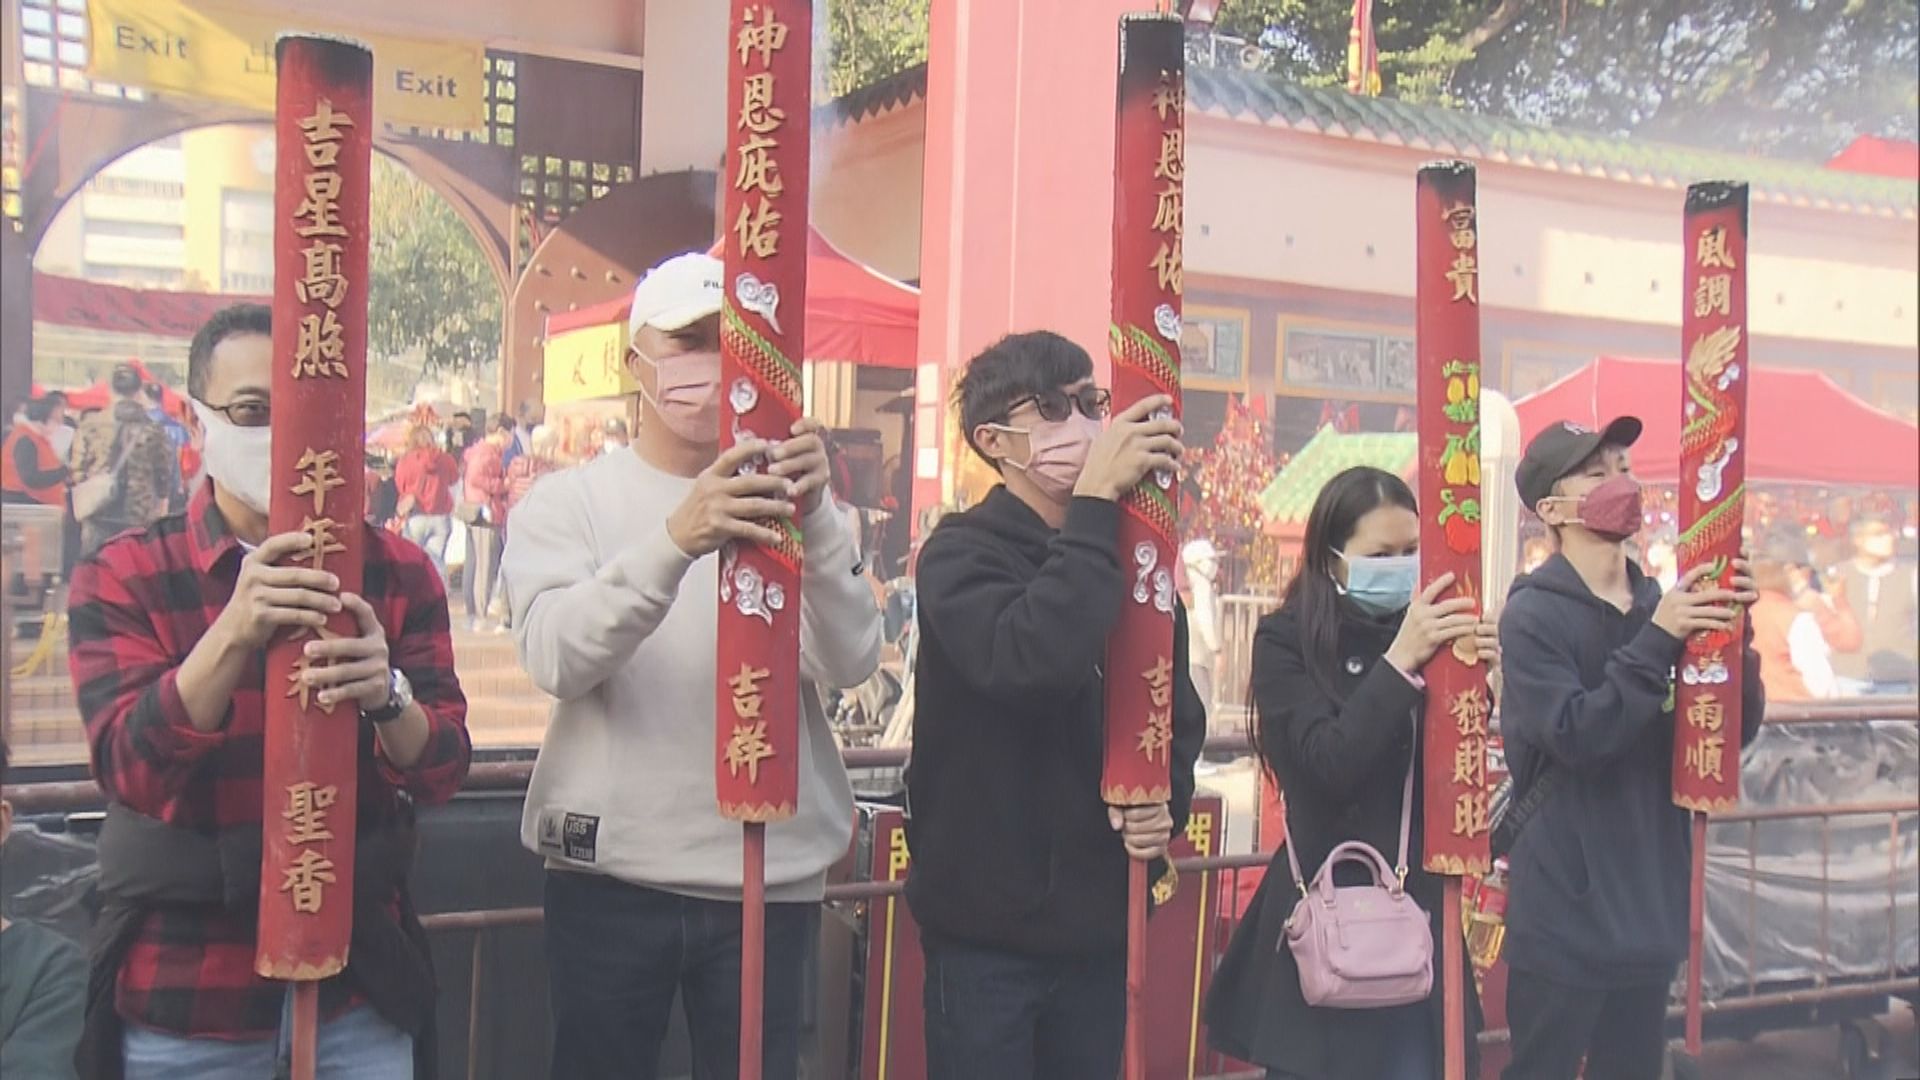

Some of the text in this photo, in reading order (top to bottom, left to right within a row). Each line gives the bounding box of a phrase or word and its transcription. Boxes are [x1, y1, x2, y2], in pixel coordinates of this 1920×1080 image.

[115, 26, 187, 59] Exit
[395, 69, 458, 98] Exit
[734, 4, 788, 261] 神恩庇佑
[1441, 205, 1478, 303] 富貴
[1694, 226, 1736, 318] 風調
[723, 661, 777, 786] 吉祥
[1136, 655, 1173, 767] 吉祥
[1447, 687, 1490, 839] 發財旺
[1684, 692, 1726, 784] 雨順
[280, 780, 338, 915] 聖香
